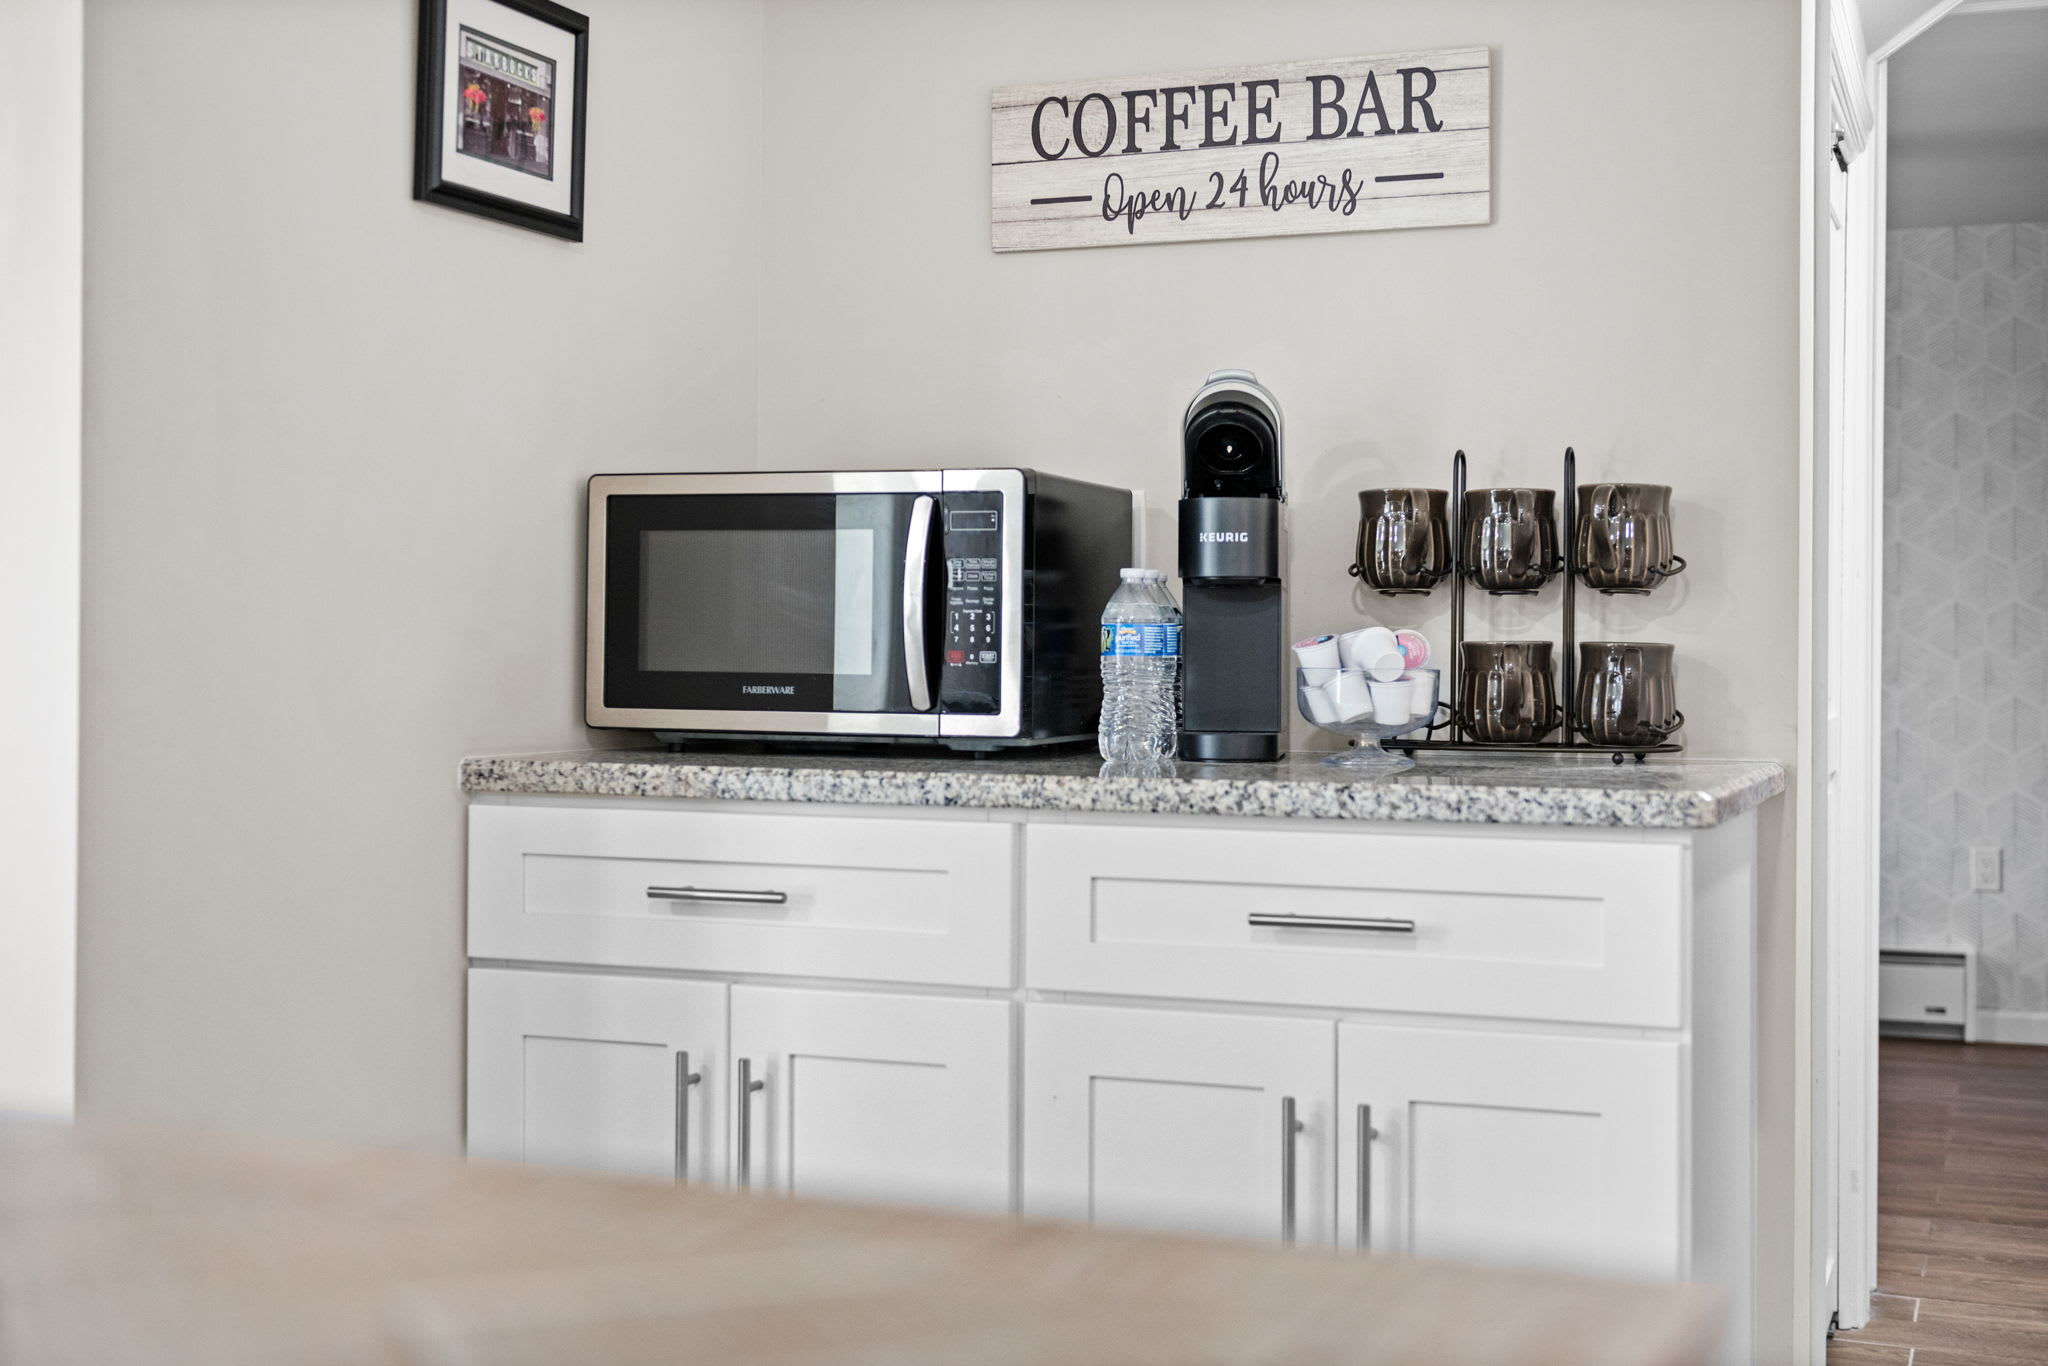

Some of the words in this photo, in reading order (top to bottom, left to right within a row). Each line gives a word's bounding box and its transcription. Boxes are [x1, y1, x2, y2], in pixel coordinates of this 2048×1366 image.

[466, 40, 538, 83] STARBUCKS
[1031, 79, 1282, 161] COFFEE
[1306, 66, 1444, 141] BAR
[1102, 172, 1196, 235] Open
[1206, 168, 1249, 211] 24
[1259, 151, 1364, 217] hours
[1199, 531, 1249, 543] KEURIG
[985, 613, 991, 621] 3
[953, 624, 959, 632] 4
[969, 624, 975, 632] 5
[985, 624, 991, 632] 6
[742, 685, 796, 695] FARBERWARE
